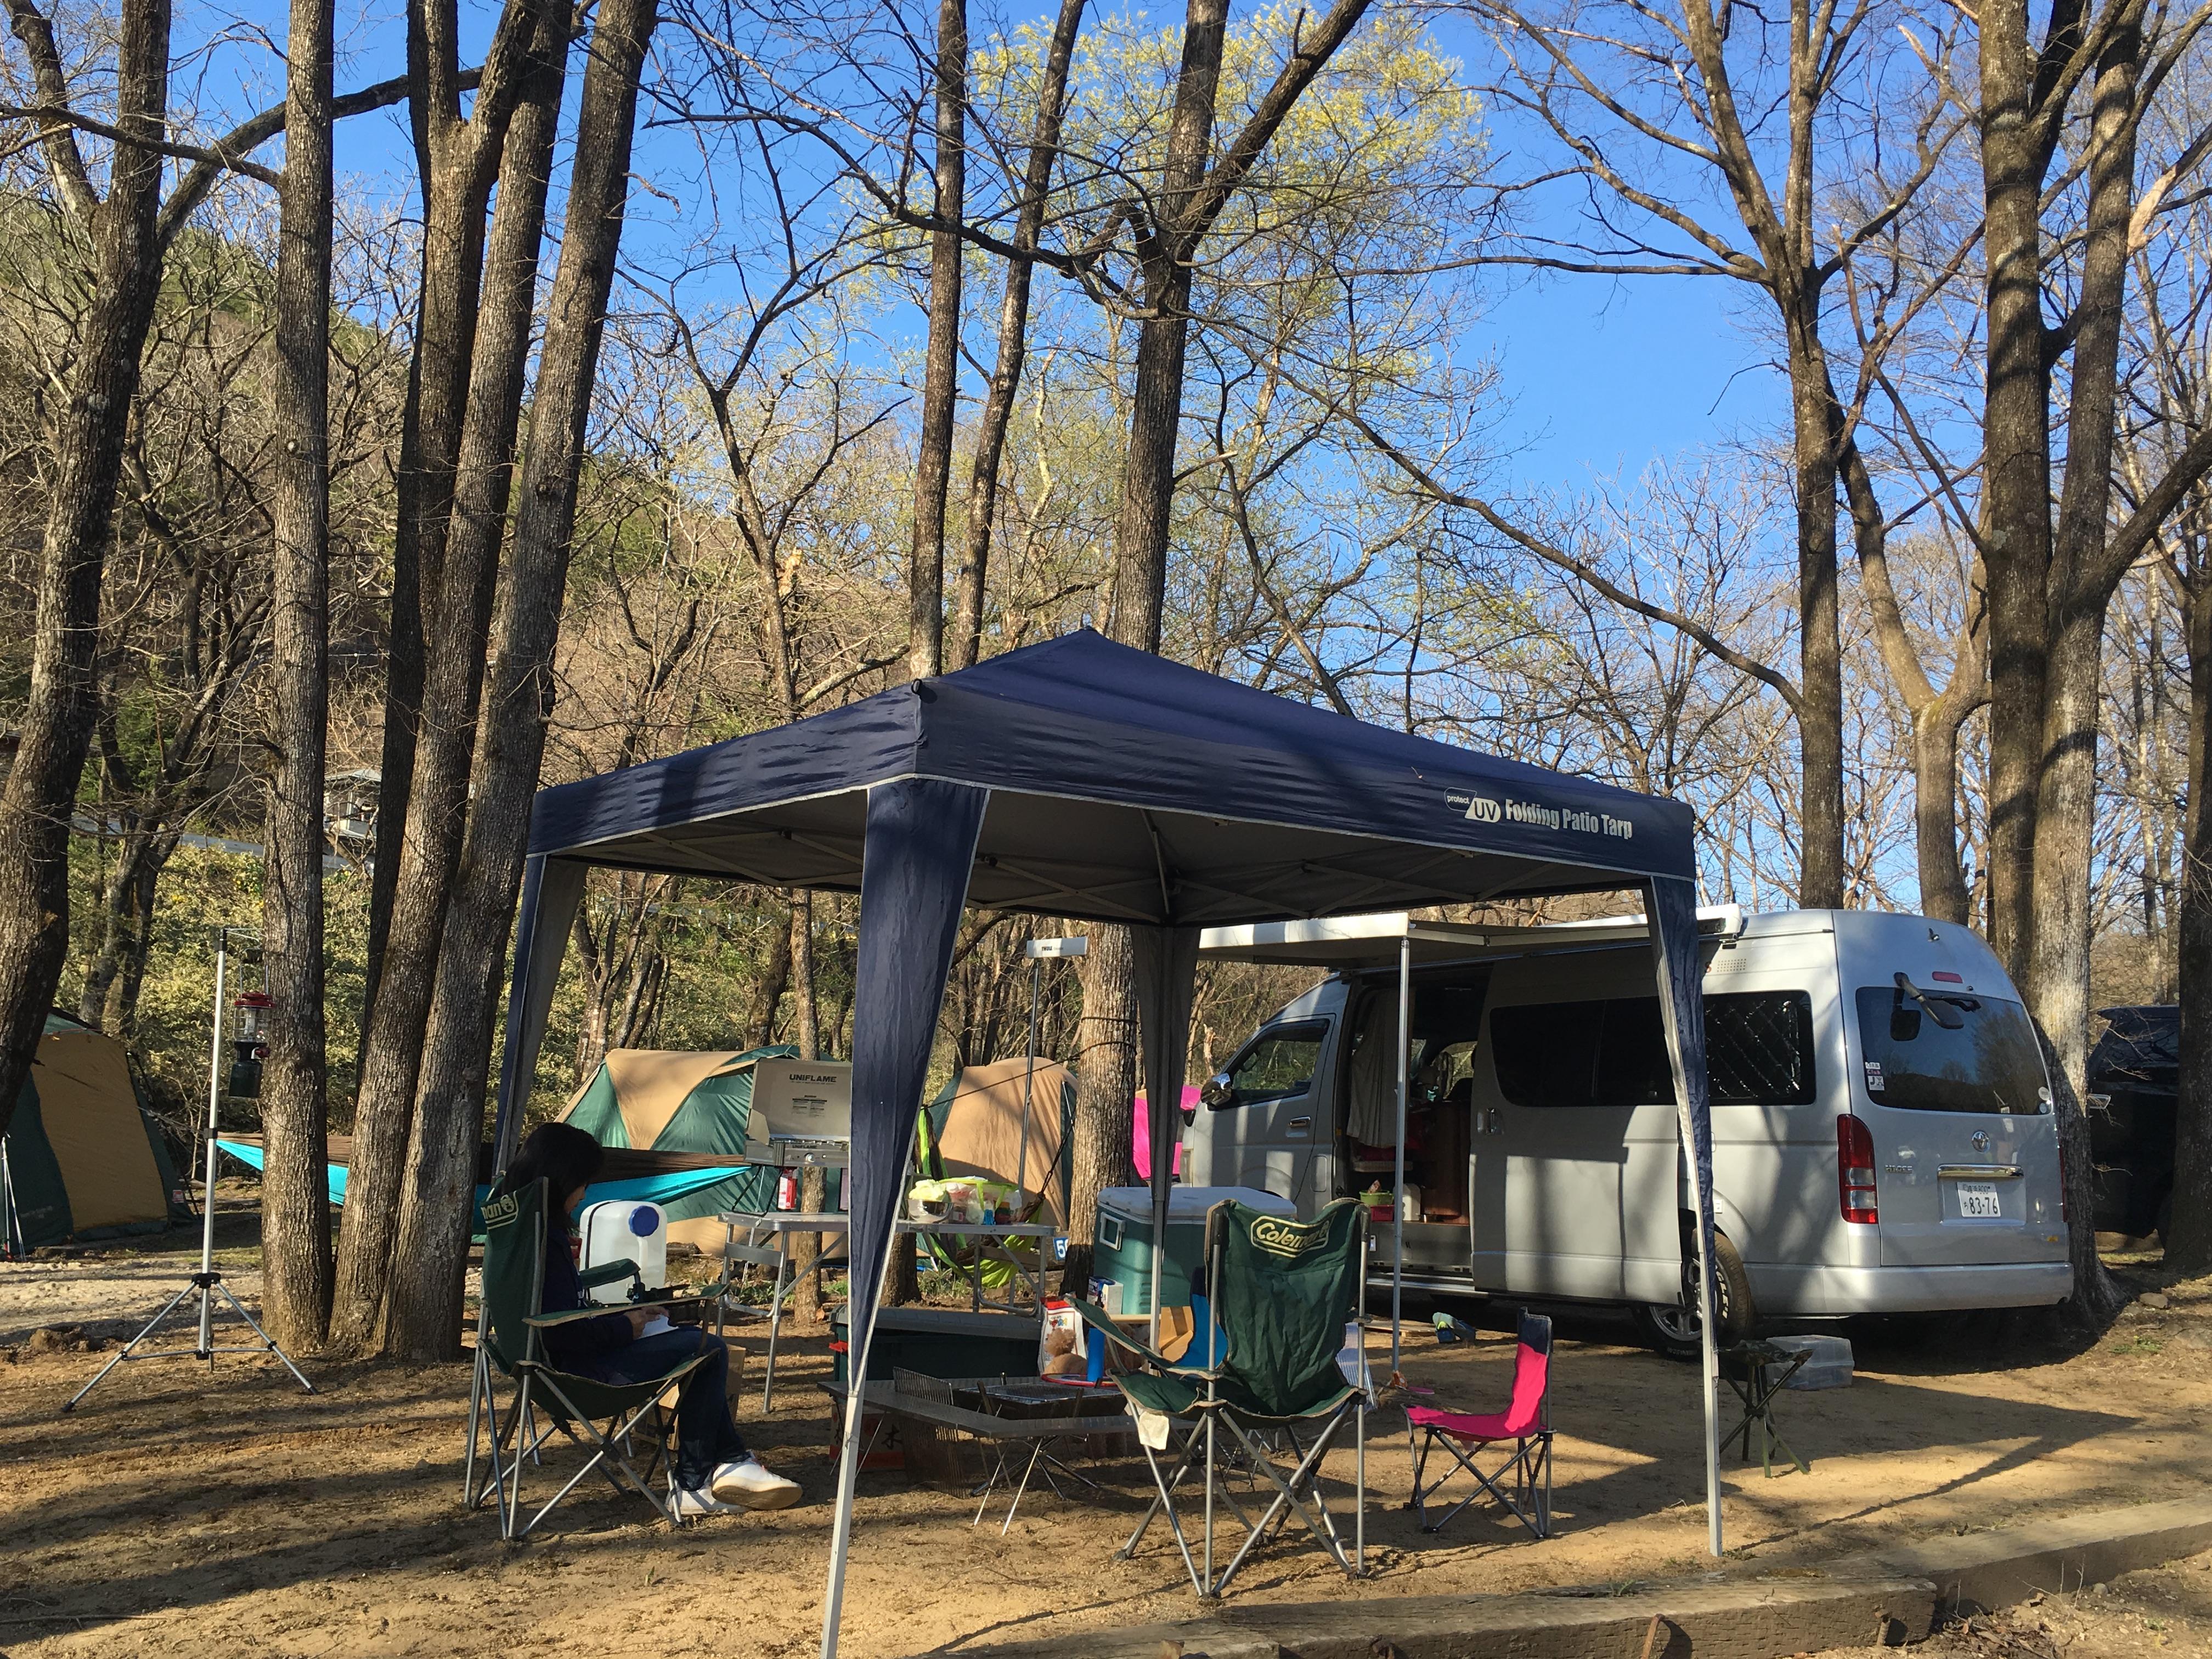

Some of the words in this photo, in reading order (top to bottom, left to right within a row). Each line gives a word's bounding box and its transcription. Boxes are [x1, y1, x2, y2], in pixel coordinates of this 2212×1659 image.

[1447, 794, 1470, 804] protect
[1474, 800, 1497, 820] UV
[1505, 799, 1559, 830] Folding
[1562, 808, 1599, 833] Patio
[1601, 814, 1633, 839] Tarp
[789, 1074, 837, 1083] UNIFLAME
[1968, 1197, 1998, 1215] 83-76
